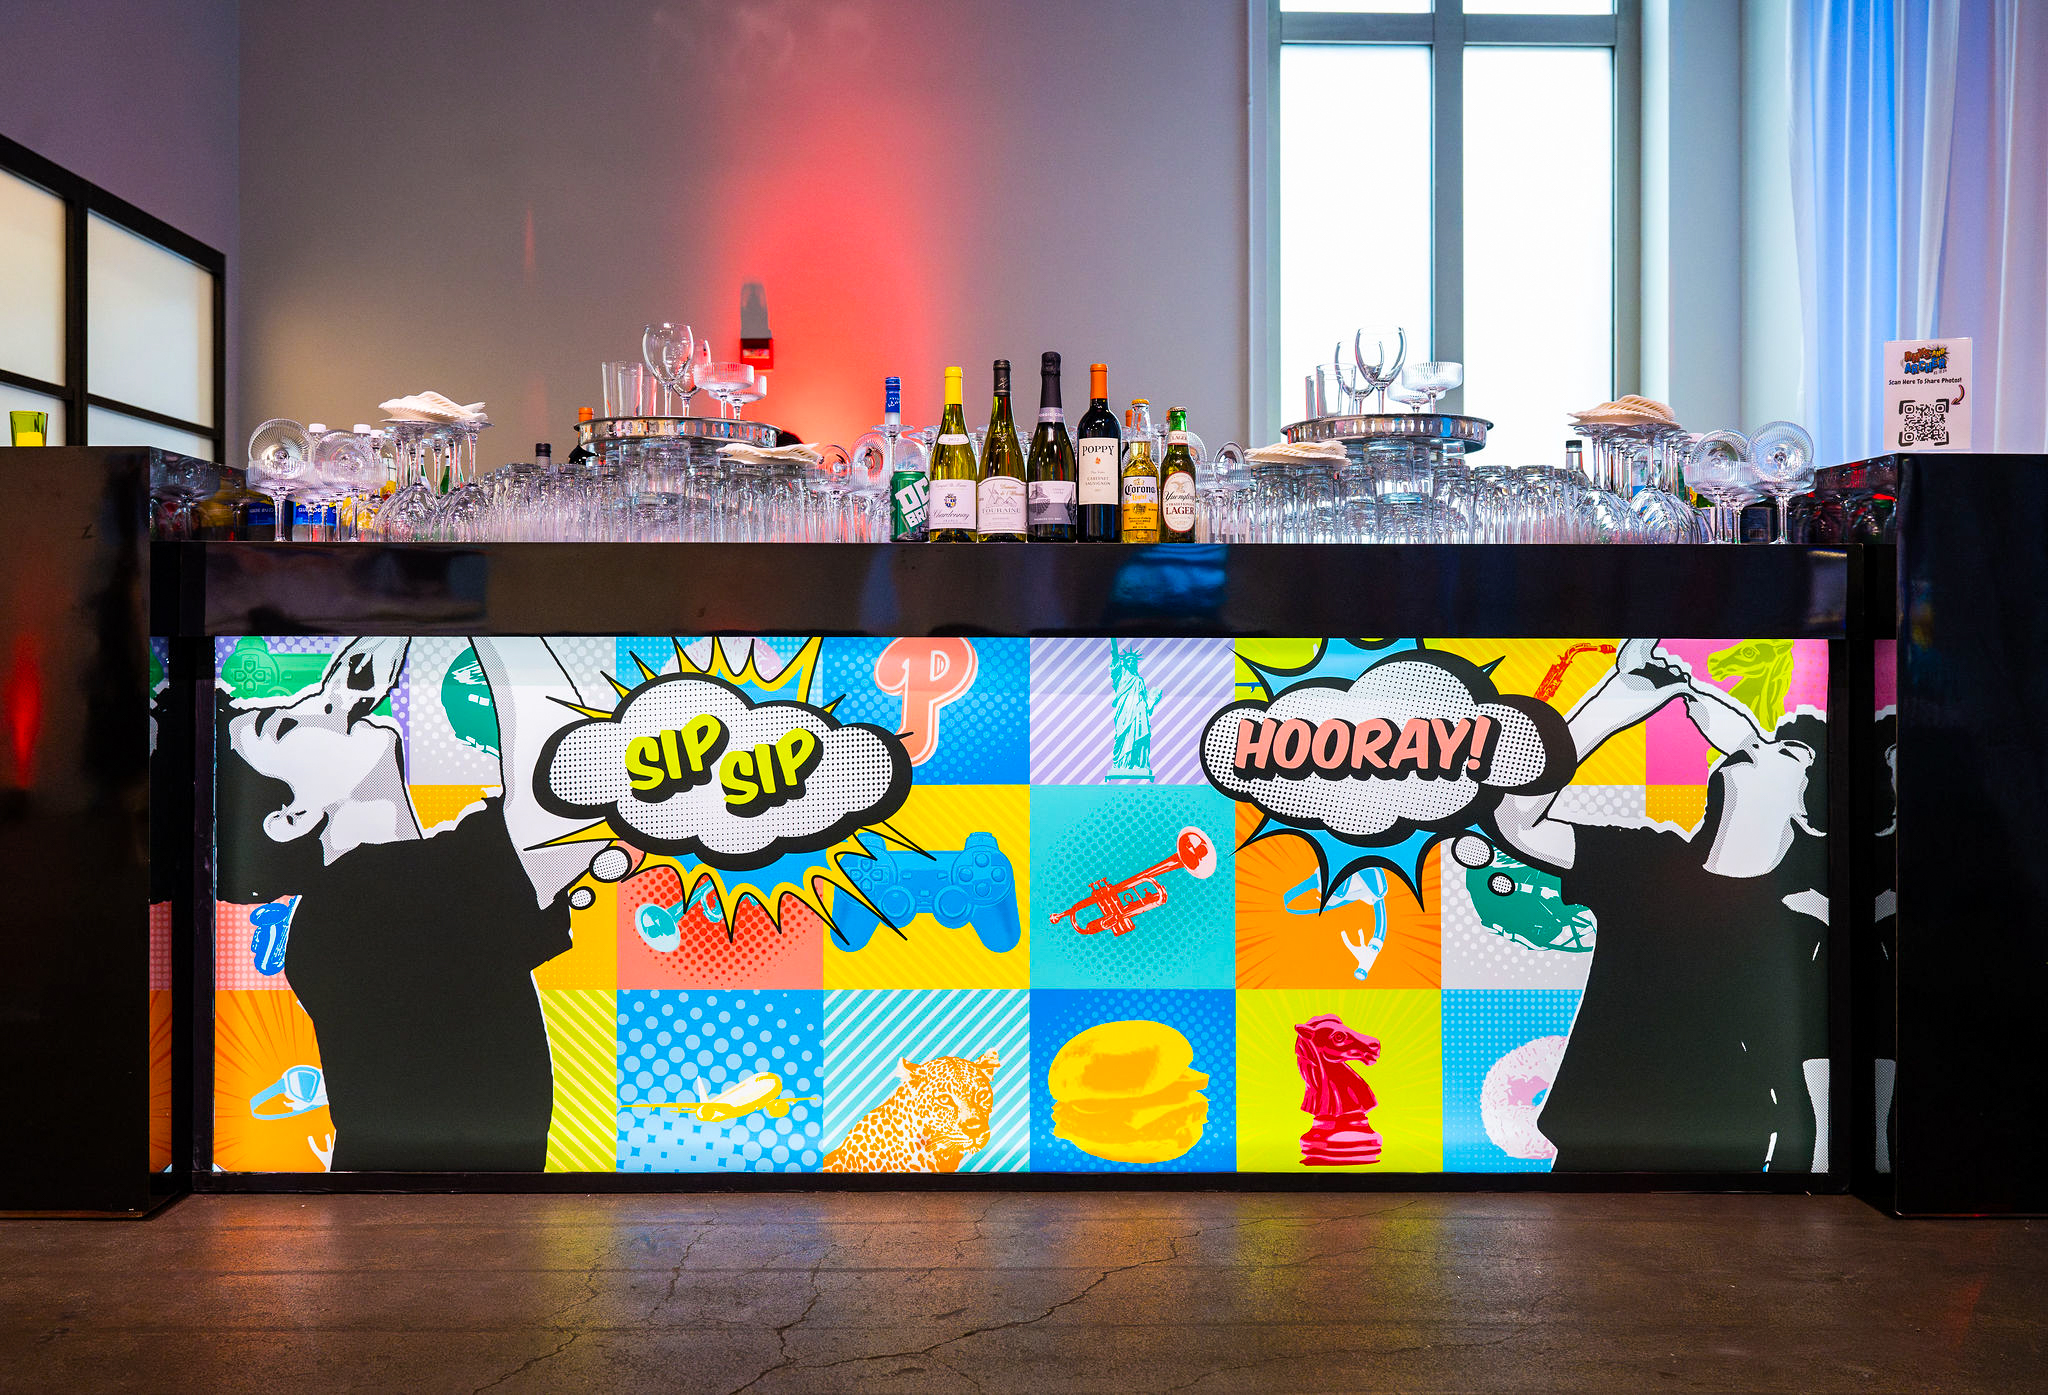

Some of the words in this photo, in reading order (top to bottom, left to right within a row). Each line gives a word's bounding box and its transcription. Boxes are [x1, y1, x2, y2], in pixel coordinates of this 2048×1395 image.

[1904, 357, 1947, 375] ARCHER
[1082, 445, 1115, 457] POPPY
[1125, 484, 1156, 496] Corona
[1166, 506, 1195, 515] LAGER
[1234, 714, 1493, 772] HOORAY!
[625, 714, 723, 792] SIP
[719, 728, 817, 806] SIP
